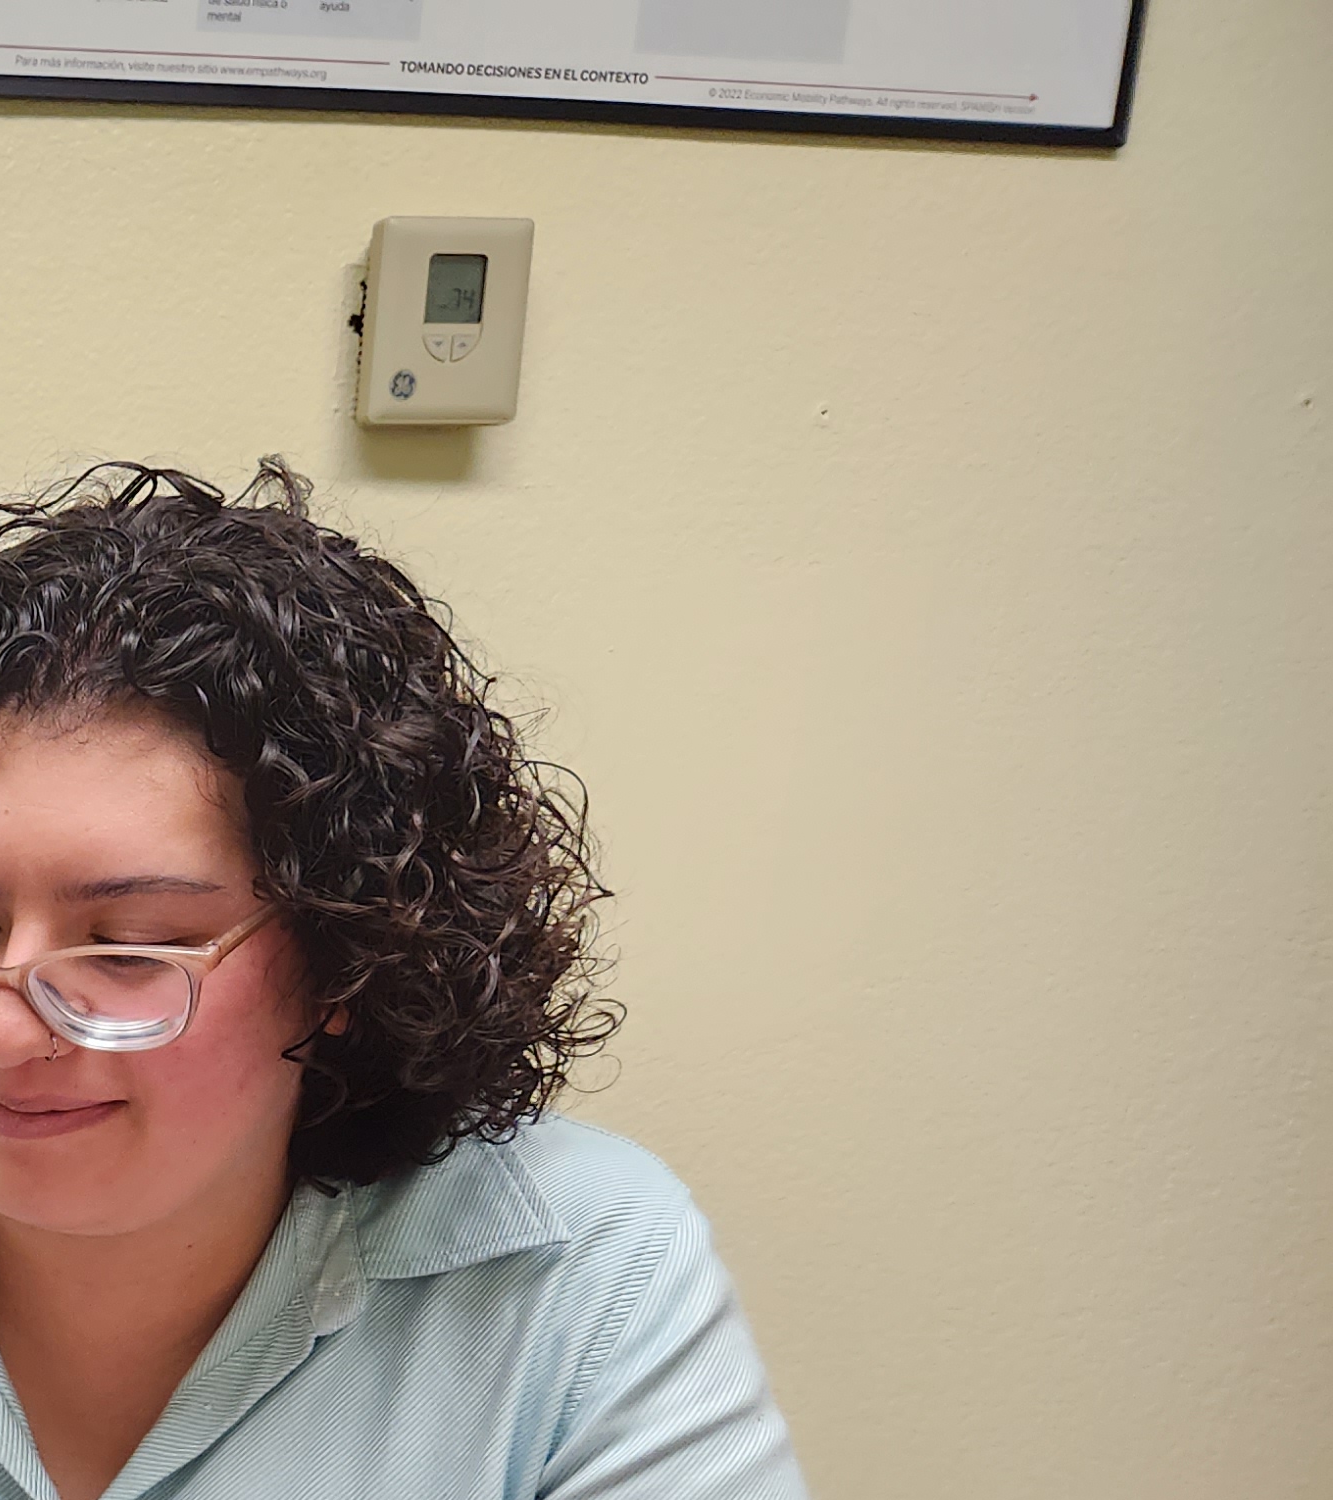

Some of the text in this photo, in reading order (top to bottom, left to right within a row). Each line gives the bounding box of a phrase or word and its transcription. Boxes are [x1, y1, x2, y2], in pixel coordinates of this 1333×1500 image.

[319, 1, 350, 12] ayuda
[207, 11, 242, 23] mental
[15, 54, 38, 67] Para
[40, 56, 61, 68] más
[128, 60, 155, 73] visite
[157, 62, 196, 75] nuestro
[399, 60, 649, 85] TOMANDO DECISIONES EN EL CONTEXTO
[719, 89, 743, 100] 2022
[744, 90, 790, 102] Economic
